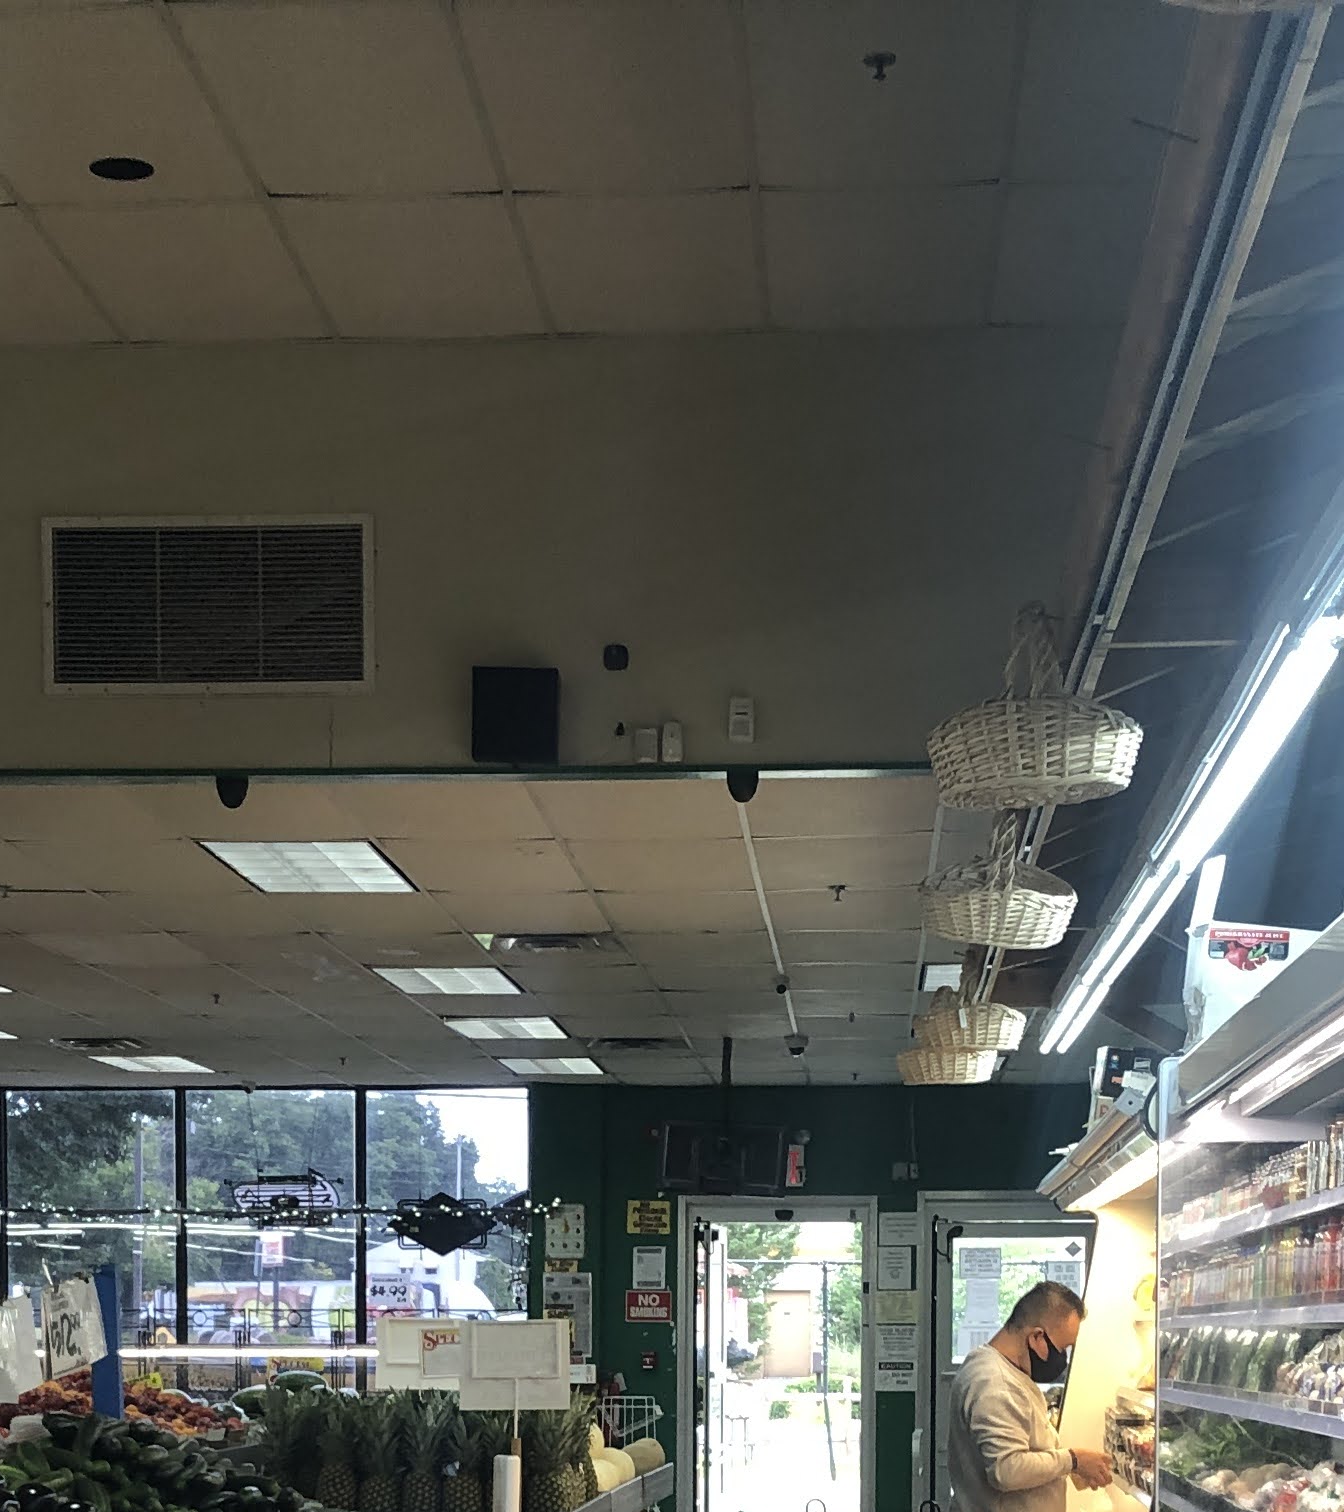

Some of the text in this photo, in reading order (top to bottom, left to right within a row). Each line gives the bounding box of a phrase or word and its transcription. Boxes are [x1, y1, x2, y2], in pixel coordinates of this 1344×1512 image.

[370, 1285, 407, 1297] $4.99
[637, 1294, 660, 1306] NO
[629, 1306, 668, 1318] SMOKING
